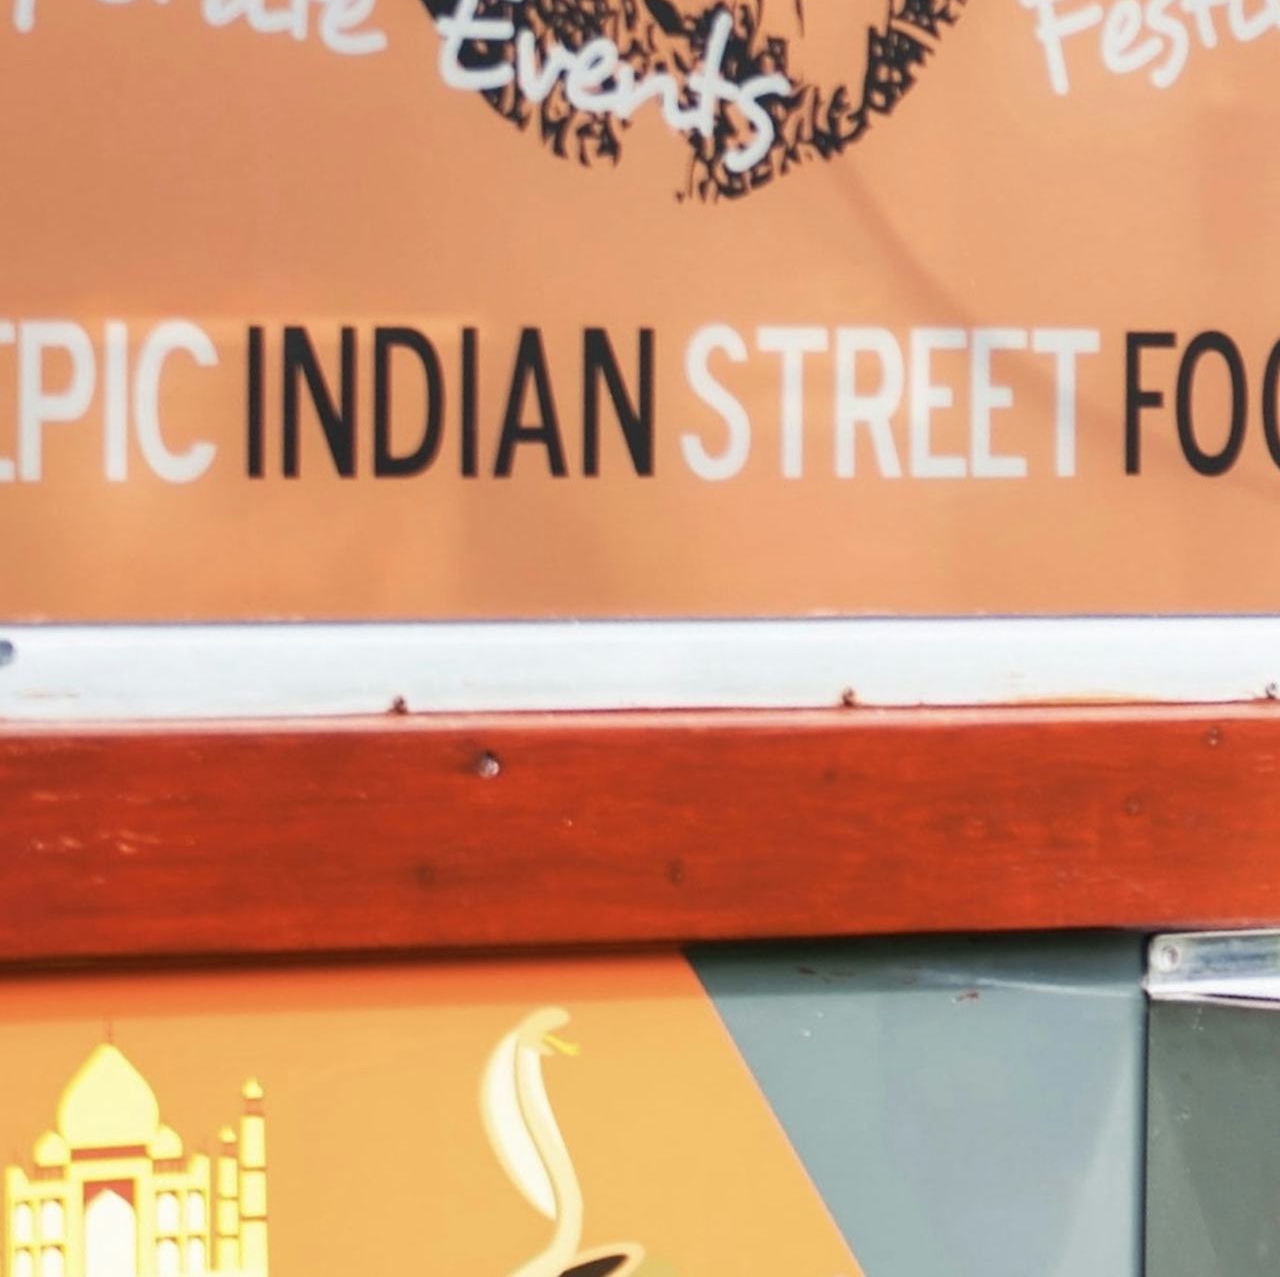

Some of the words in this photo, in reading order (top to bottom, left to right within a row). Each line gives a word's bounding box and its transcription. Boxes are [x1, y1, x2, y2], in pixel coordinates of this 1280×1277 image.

[0, 316, 220, 484] PIC
[245, 324, 656, 480] INDIAN
[680, 322, 1100, 482] STREET
